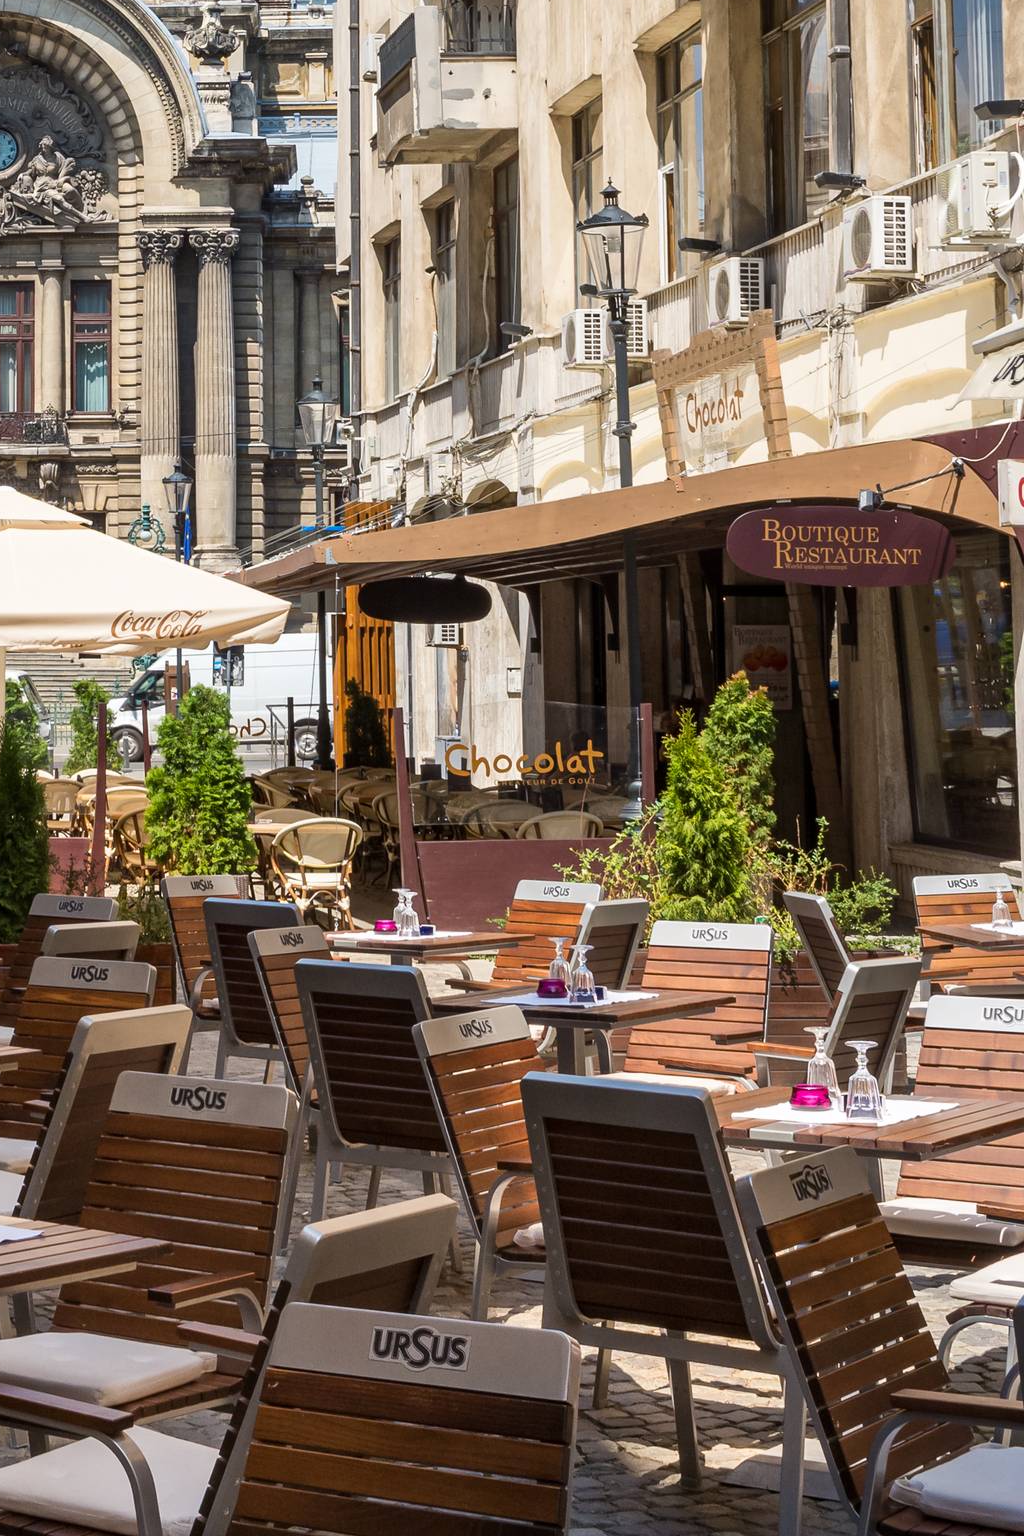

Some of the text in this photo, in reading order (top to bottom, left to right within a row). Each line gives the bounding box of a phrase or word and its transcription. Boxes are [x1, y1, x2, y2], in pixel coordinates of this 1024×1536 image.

[685, 376, 743, 433] Chocolat
[761, 518, 879, 545] BOUTIQUE
[773, 540, 922, 569] RESTAURANT
[111, 609, 208, 639] Coca-Cola
[445, 738, 604, 777] Chocolat
[190, 879, 214, 892] URSUS
[543, 885, 570, 898] URSUS
[947, 878, 978, 889] URSUS
[59, 900, 84, 913] URSUS
[279, 931, 304, 947] URSUS
[692, 927, 728, 942] URSUS
[71, 965, 109, 982] URSUS
[983, 1005, 1024, 1024] URSU
[459, 1019, 493, 1038] URSUS
[170, 1086, 227, 1111] URSUS
[791, 1169, 829, 1201] URSUS
[373, 1327, 467, 1368] URSUS
